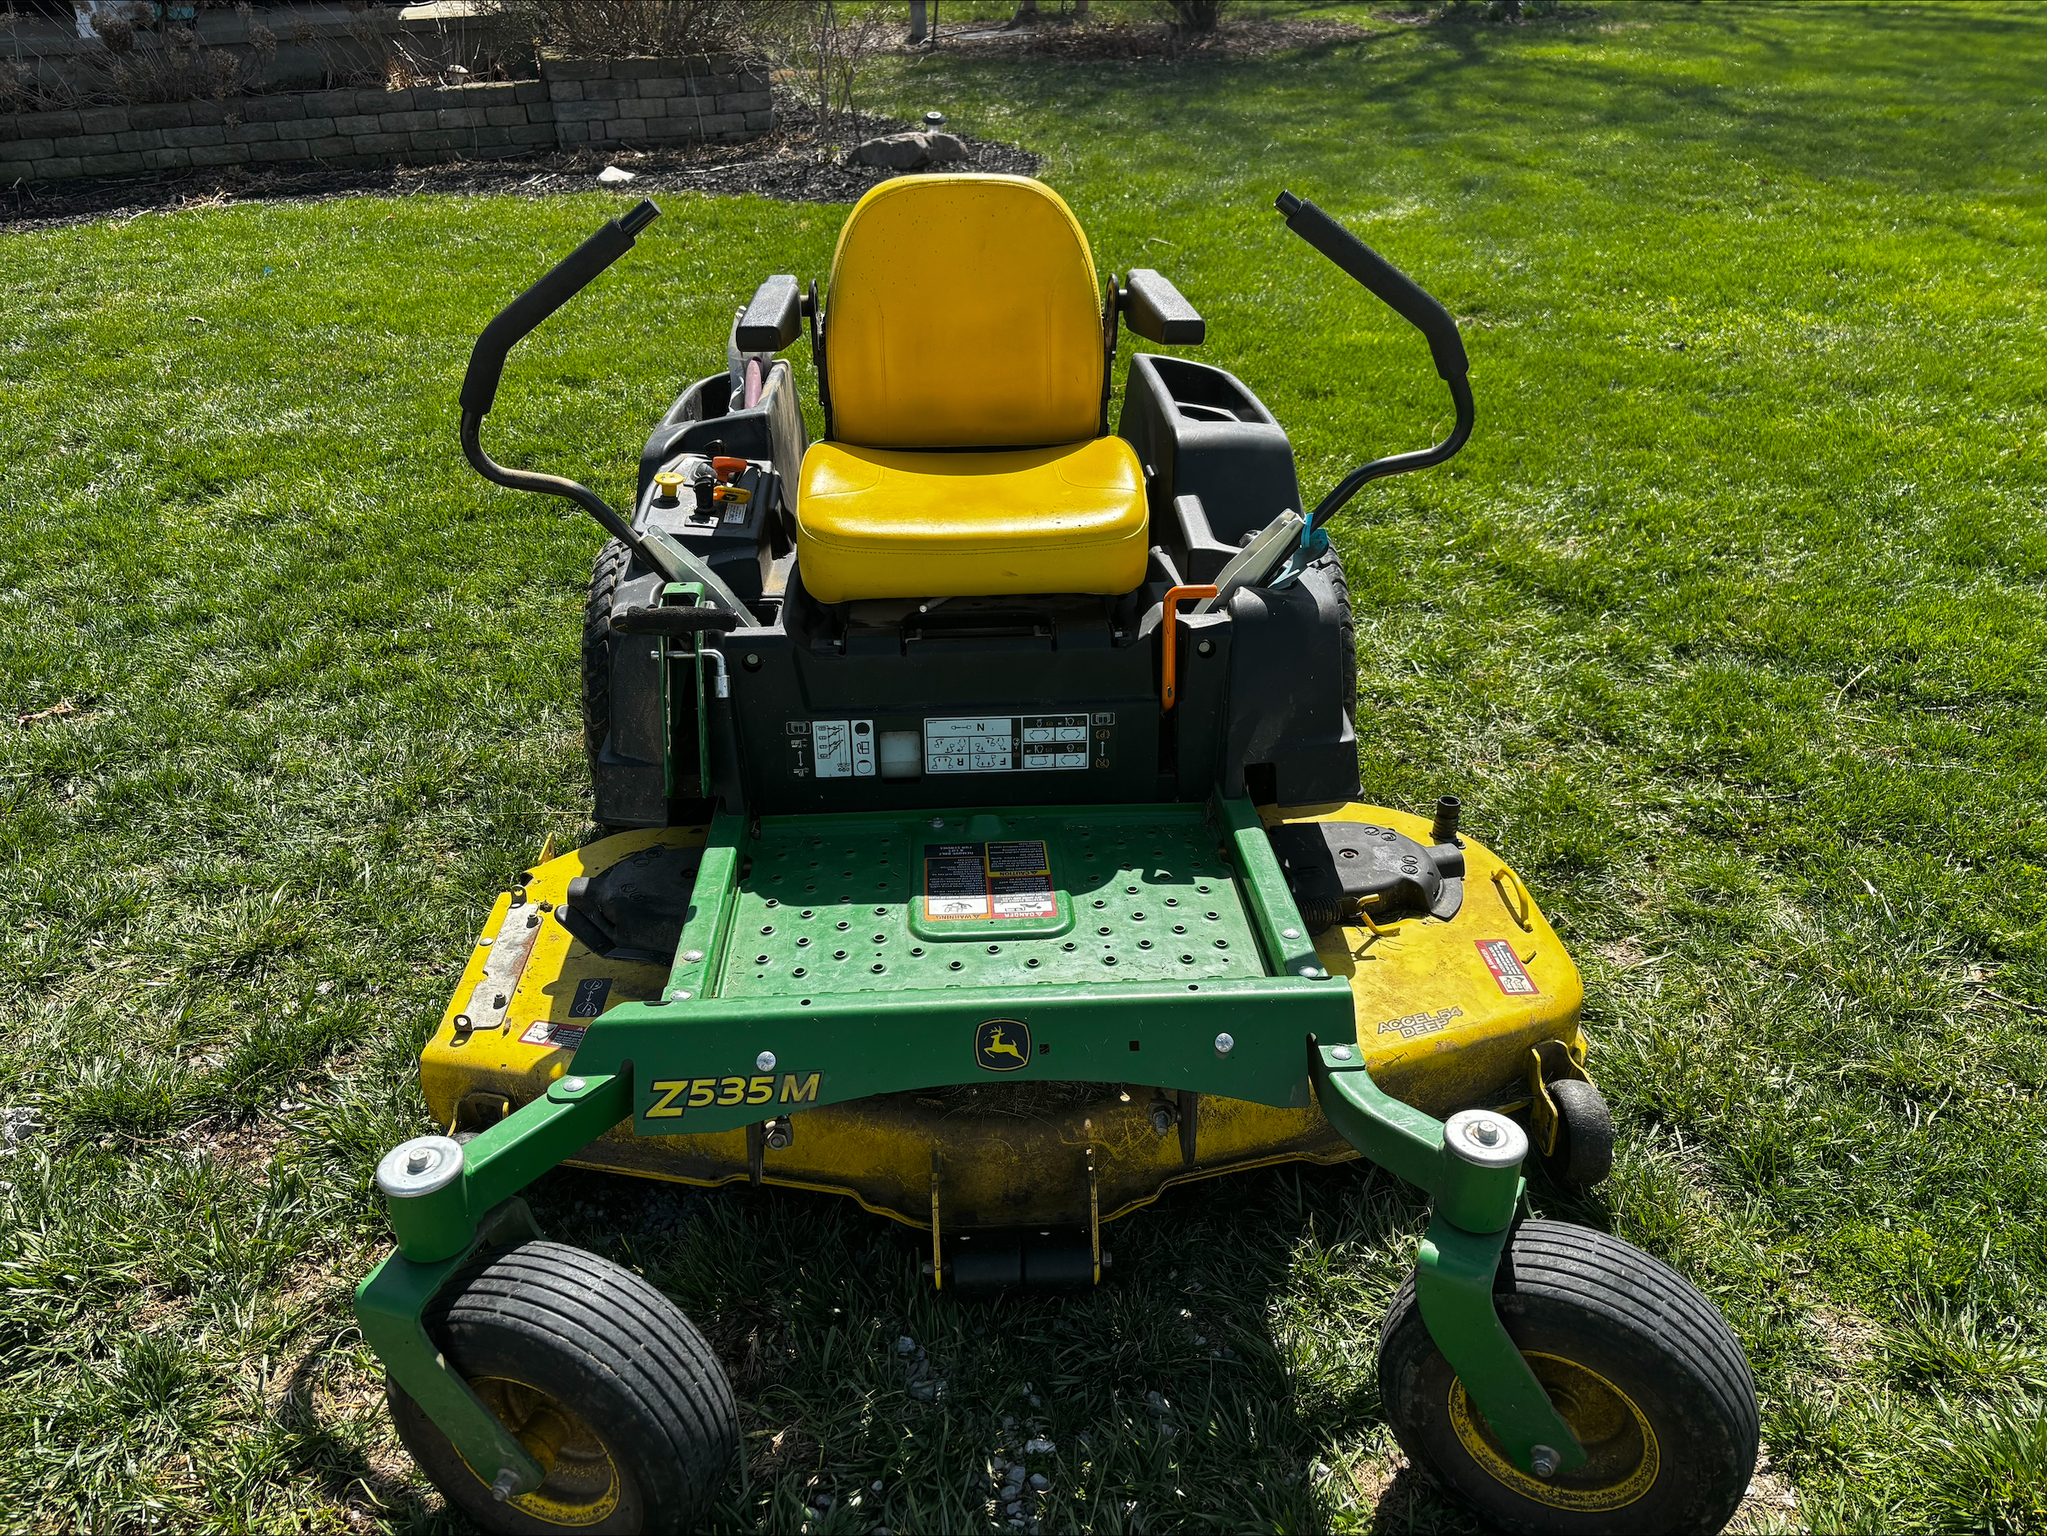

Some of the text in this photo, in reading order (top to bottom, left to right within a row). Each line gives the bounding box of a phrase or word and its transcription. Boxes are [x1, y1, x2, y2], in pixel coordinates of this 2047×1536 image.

[977, 723, 984, 731] N
[957, 758, 964, 766] R
[1377, 1005, 1463, 1035] ACCEL 54
[1400, 1018, 1450, 1039] DEEP
